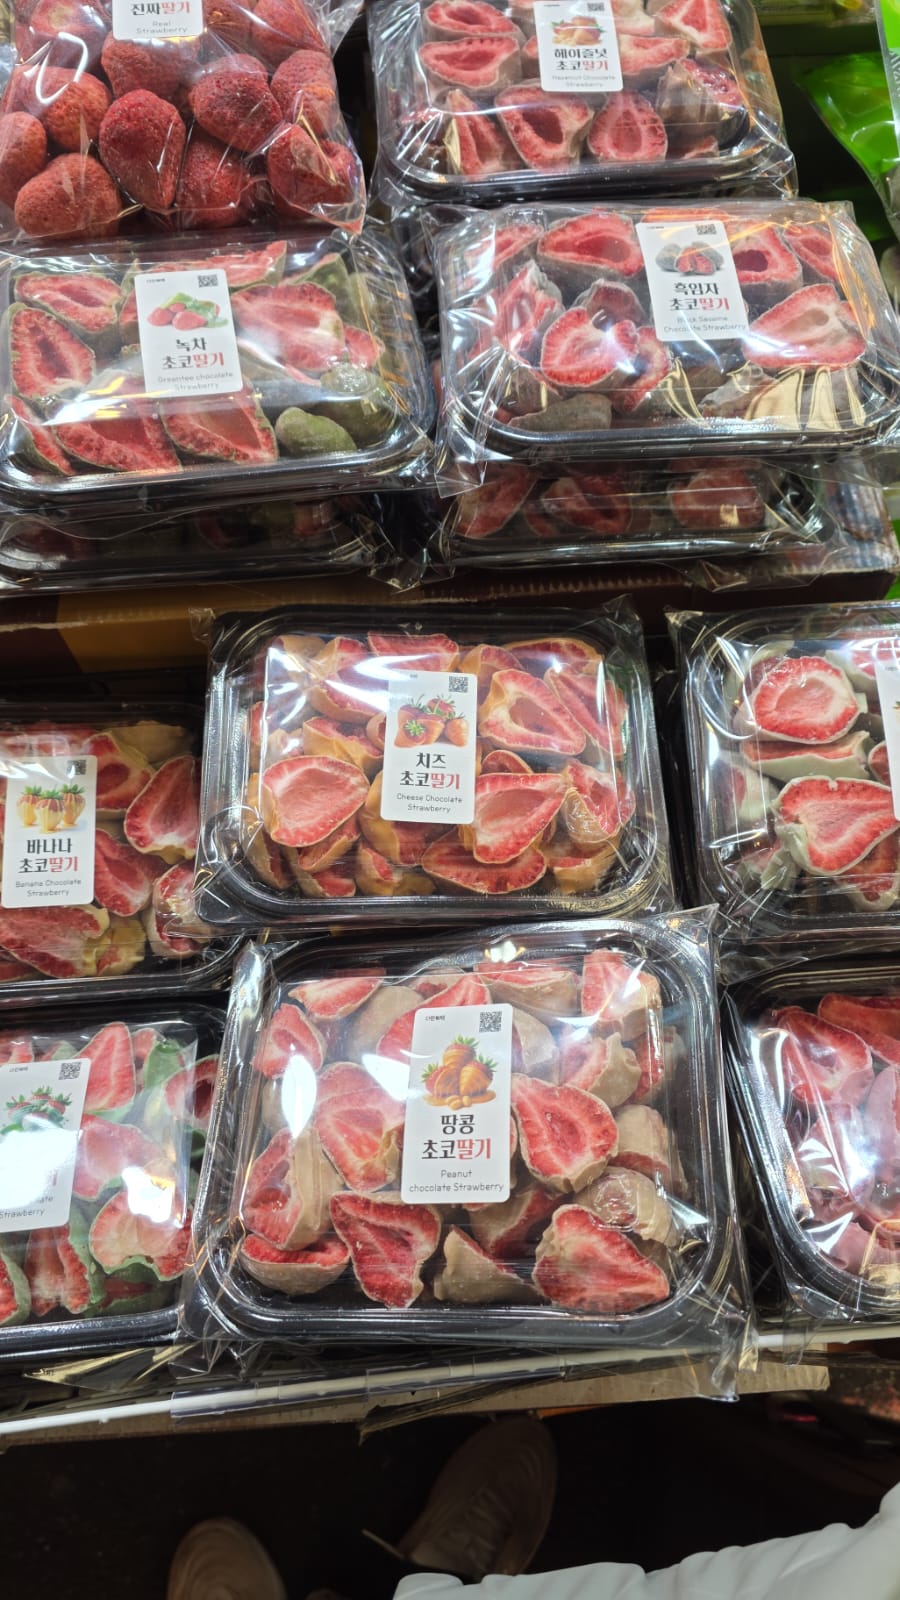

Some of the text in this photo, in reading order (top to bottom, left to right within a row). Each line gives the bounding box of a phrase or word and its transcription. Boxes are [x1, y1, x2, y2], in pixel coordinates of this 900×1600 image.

[131, 1, 190, 15] 진짜딸기
[554, 48, 608, 58] 헤이즐넛
[556, 60, 608, 71] 초코딸기
[674, 282, 719, 295] 흑임자
[670, 297, 729, 311] 초코딸기
[703, 323, 745, 332] Strawberry
[176, 337, 207, 351] 녹차
[162, 352, 224, 369] 초코딸기
[175, 382, 218, 391] Strawberry
[415, 752, 446, 769] 치즈
[400, 770, 460, 790] 초코딸기
[396, 793, 463, 804] Cheese Chocolate
[407, 803, 451, 814] Strawberry
[27, 838, 72, 854] 바나나
[18, 856, 78, 874] 초코딸기
[45, 878, 81, 887] Chocolate
[27, 888, 69, 898] Strawberry
[440, 1114, 475, 1135] 땅콩
[421, 1138, 491, 1160] 초코딸기
[440, 1169, 472, 1179] Peanut
[409, 1181, 504, 1194] chocolate Strawberry
